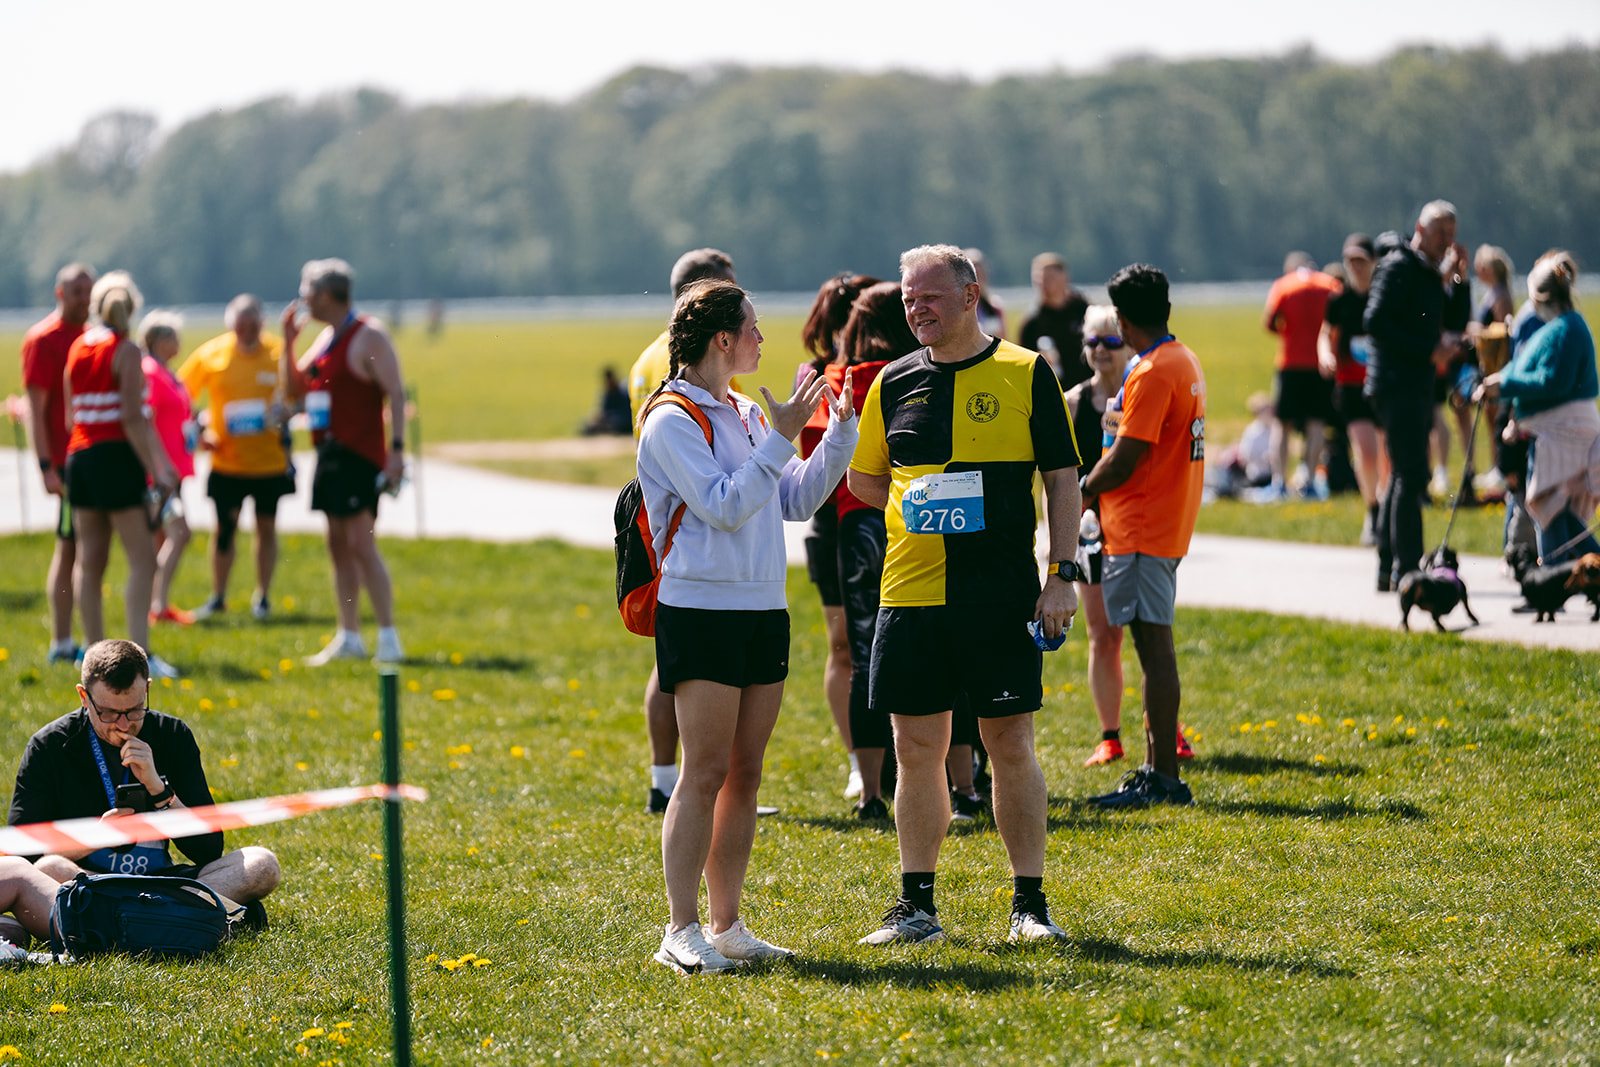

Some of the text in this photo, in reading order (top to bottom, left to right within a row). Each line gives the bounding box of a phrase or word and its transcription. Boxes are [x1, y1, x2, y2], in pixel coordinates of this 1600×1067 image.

[909, 489, 928, 501] 10k
[919, 507, 966, 531] 276
[91, 739, 104, 760] TEWV
[98, 760, 108, 775] 10k
[108, 852, 149, 875] 188
